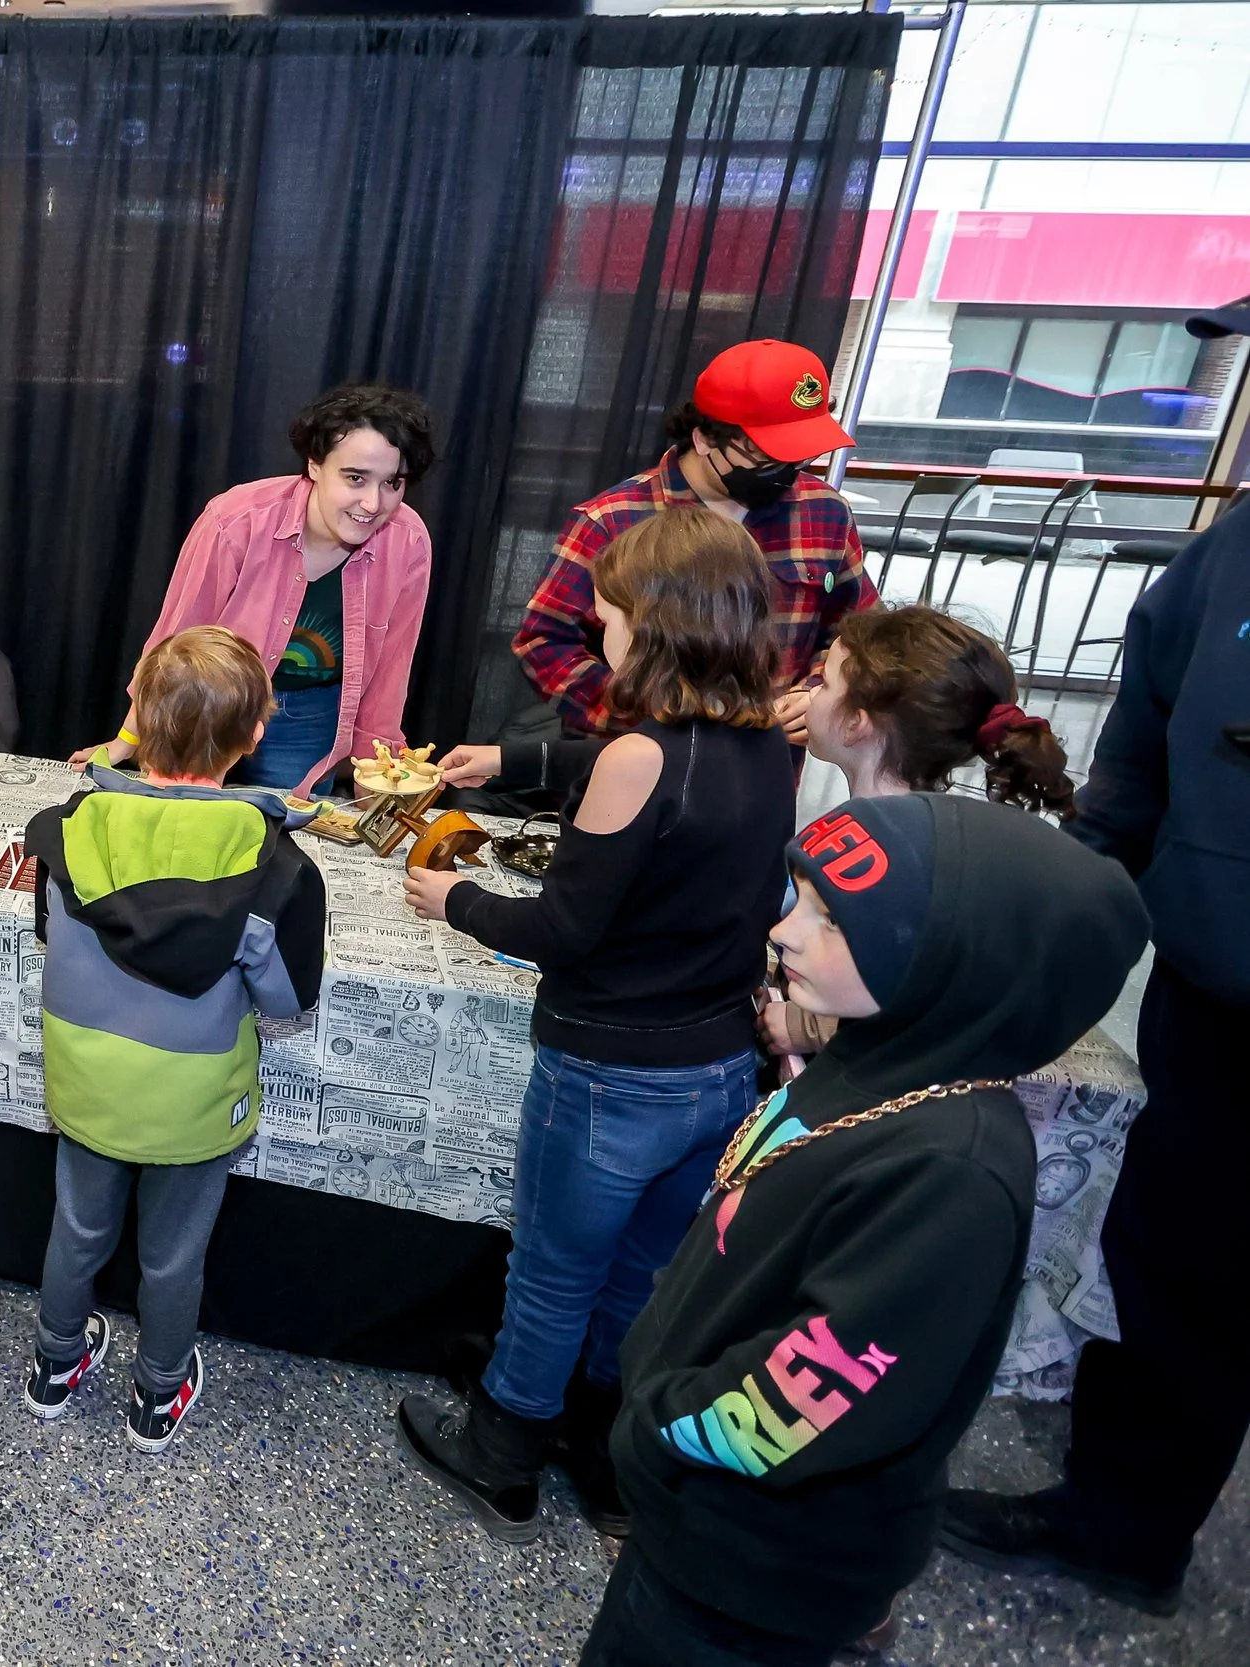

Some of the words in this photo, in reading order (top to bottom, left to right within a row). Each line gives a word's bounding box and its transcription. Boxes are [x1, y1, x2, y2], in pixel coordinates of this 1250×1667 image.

[331, 1004, 351, 1013] GLOSS
[355, 1009, 391, 1020] BALMORAL
[260, 1103, 312, 1122] ATERBURY
[327, 1109, 361, 1124] GLOSS
[434, 1103, 445, 1112] Le
[450, 1106, 490, 1121] Journal
[497, 1113, 521, 1124] illust
[367, 1113, 422, 1133] BALMORAL
[660, 1315, 878, 1478] URLEY
